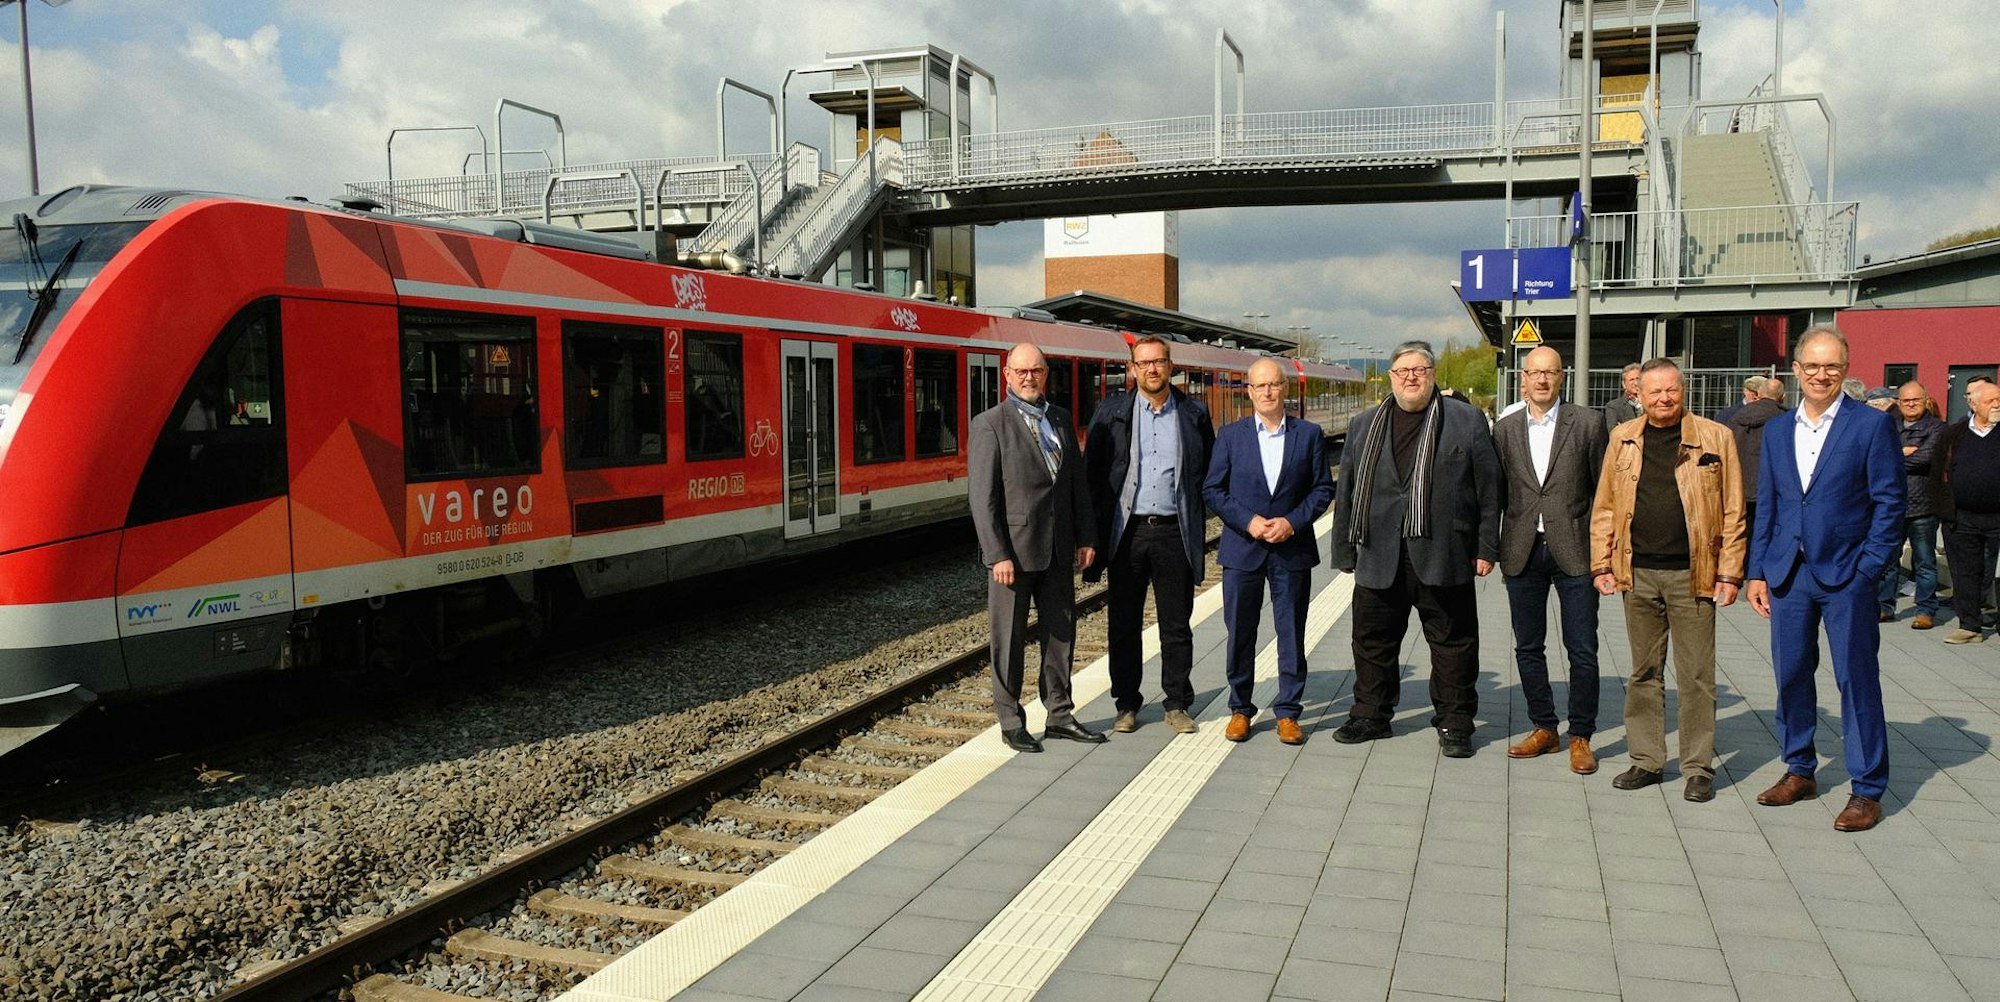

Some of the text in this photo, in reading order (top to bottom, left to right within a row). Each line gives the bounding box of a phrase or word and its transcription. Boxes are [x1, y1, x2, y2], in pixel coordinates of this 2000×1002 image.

[1468, 254, 1484, 290] 1
[1524, 280, 1554, 289] Richtung
[668, 330, 679, 359] 2
[905, 348, 912, 369] 2
[688, 473, 745, 500] REGIO DB
[417, 484, 533, 526] vareo
[423, 521, 533, 546] DER ZUG FÜR DIE REGION
[208, 601, 241, 615] NWL
